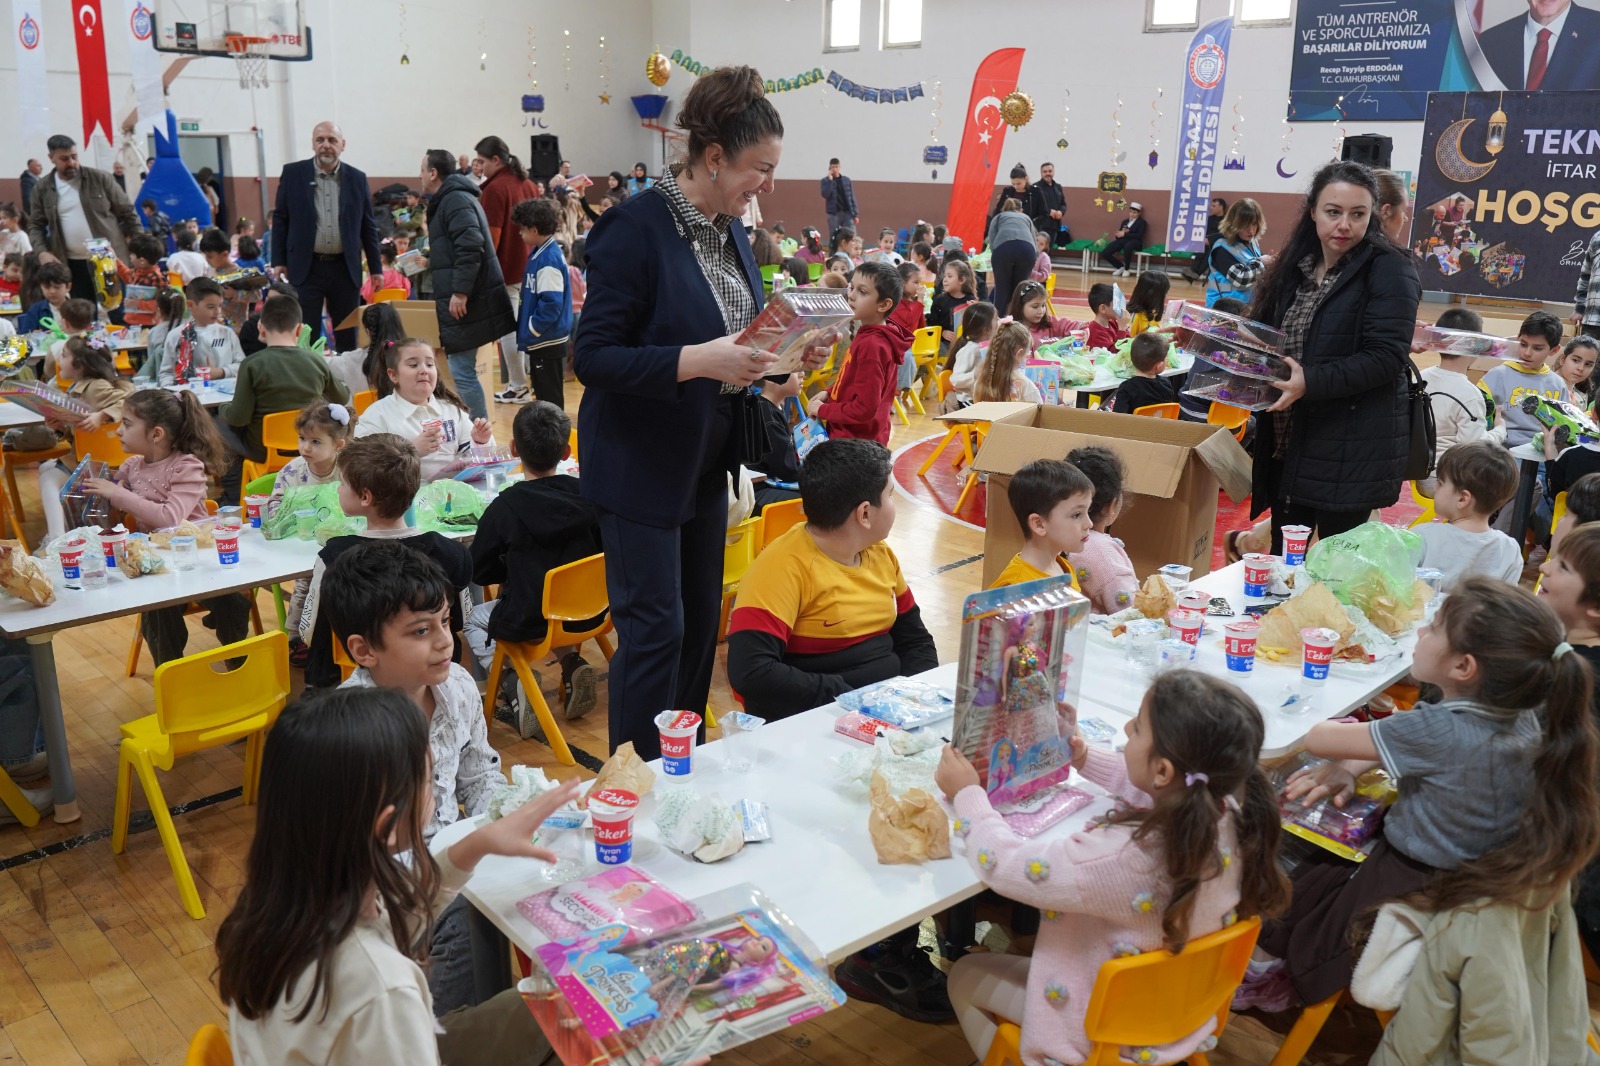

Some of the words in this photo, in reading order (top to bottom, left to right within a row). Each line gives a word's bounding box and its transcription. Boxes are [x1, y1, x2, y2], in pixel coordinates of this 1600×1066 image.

[1317, 13, 1344, 27] TÜM
[1347, 8, 1418, 26] ANTRENÖR
[1302, 29, 1317, 41] VE
[1319, 23, 1431, 40] SPORCULARIMIZA
[1303, 42, 1362, 55] BAŞARILAR
[1364, 39, 1427, 52] DİLİYORUM
[1320, 67, 1341, 75] Recep
[1342, 65, 1365, 74] Tayyip
[1366, 63, 1403, 72] ERDOĞAN
[1322, 76, 1334, 84] T.C.
[1335, 74, 1400, 84] CUMHURBAŞKANI
[1173, 103, 1203, 243] ORHANGAZİ
[1191, 105, 1220, 242] BELEDİYESİ
[1546, 159, 1597, 179] İFTAR
[1475, 189, 1600, 234] HOŞG
[599, 846, 622, 856] Ayran
[582, 965, 634, 1014] PRINCESS
